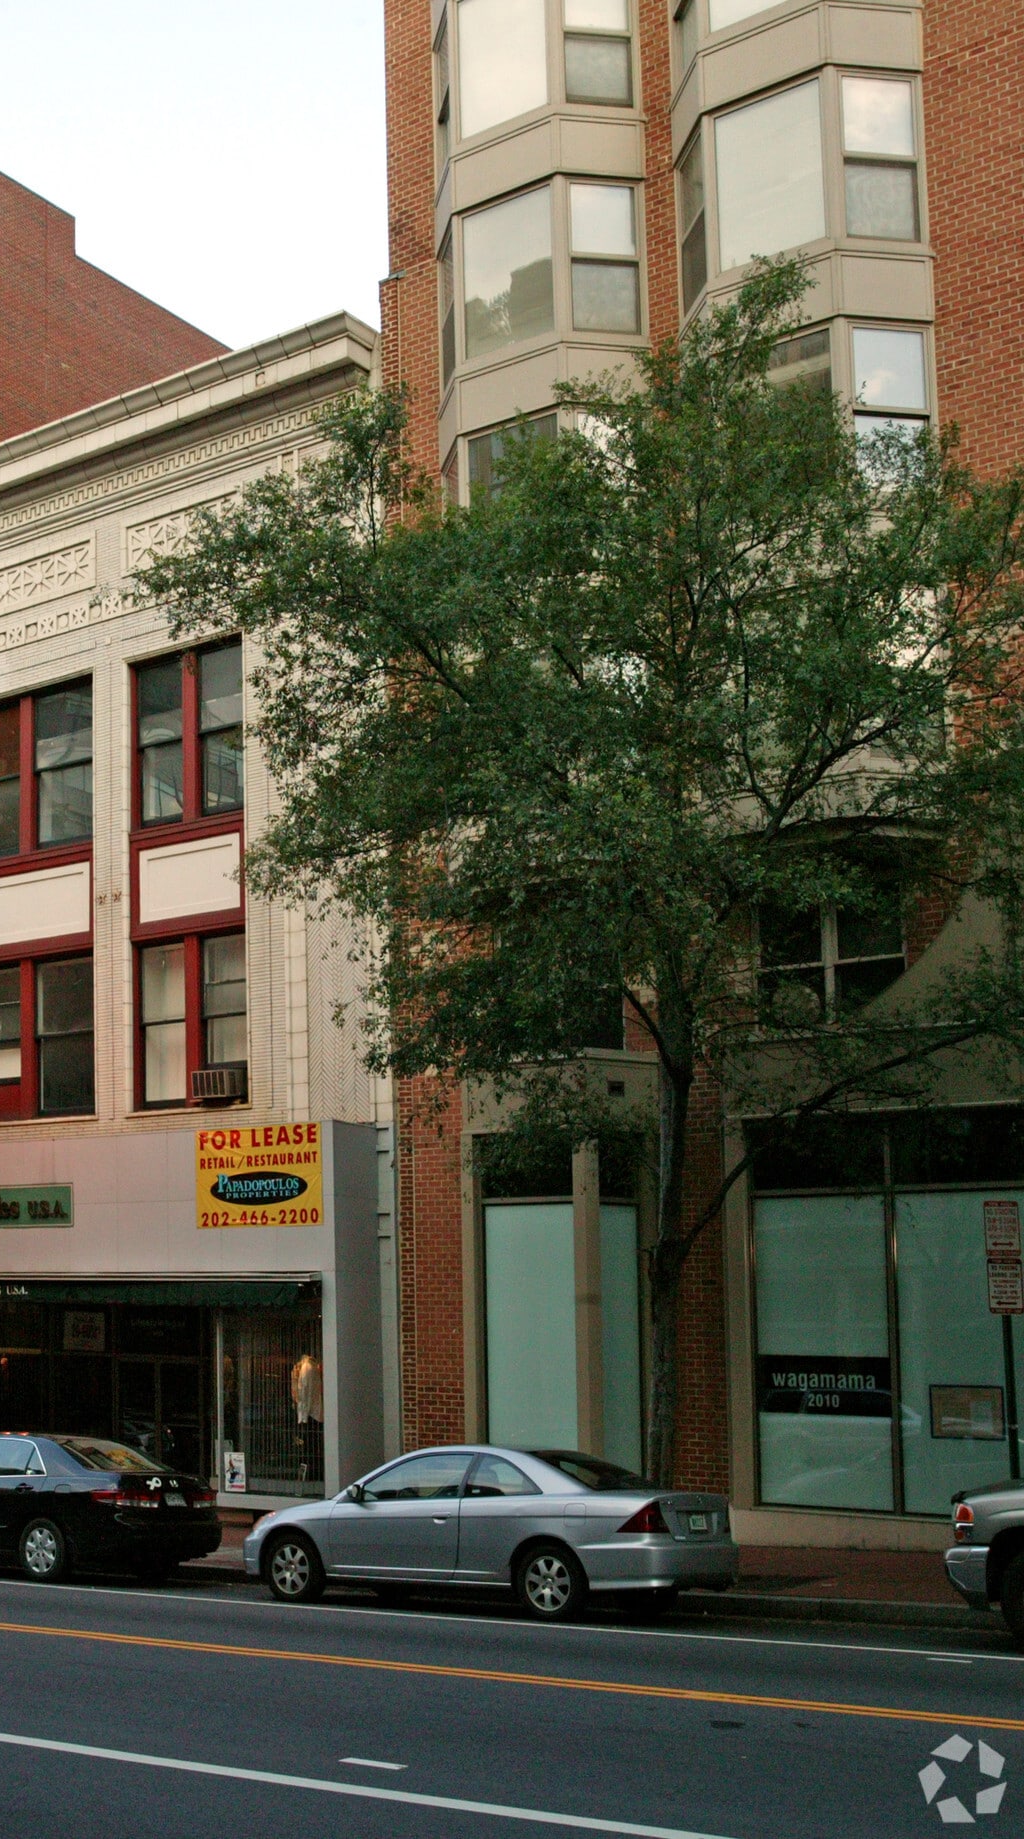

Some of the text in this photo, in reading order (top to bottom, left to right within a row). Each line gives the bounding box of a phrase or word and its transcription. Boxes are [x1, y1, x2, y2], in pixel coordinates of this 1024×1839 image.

[199, 1123, 318, 1151] FOR LEASE
[217, 1173, 300, 1193] PAPADOPOULOS
[226, 1189, 299, 1199] PROPERTIES
[201, 1207, 319, 1227] 202-466-2200
[772, 1372, 876, 1391] wagamama
[808, 1393, 840, 1408] 2010
